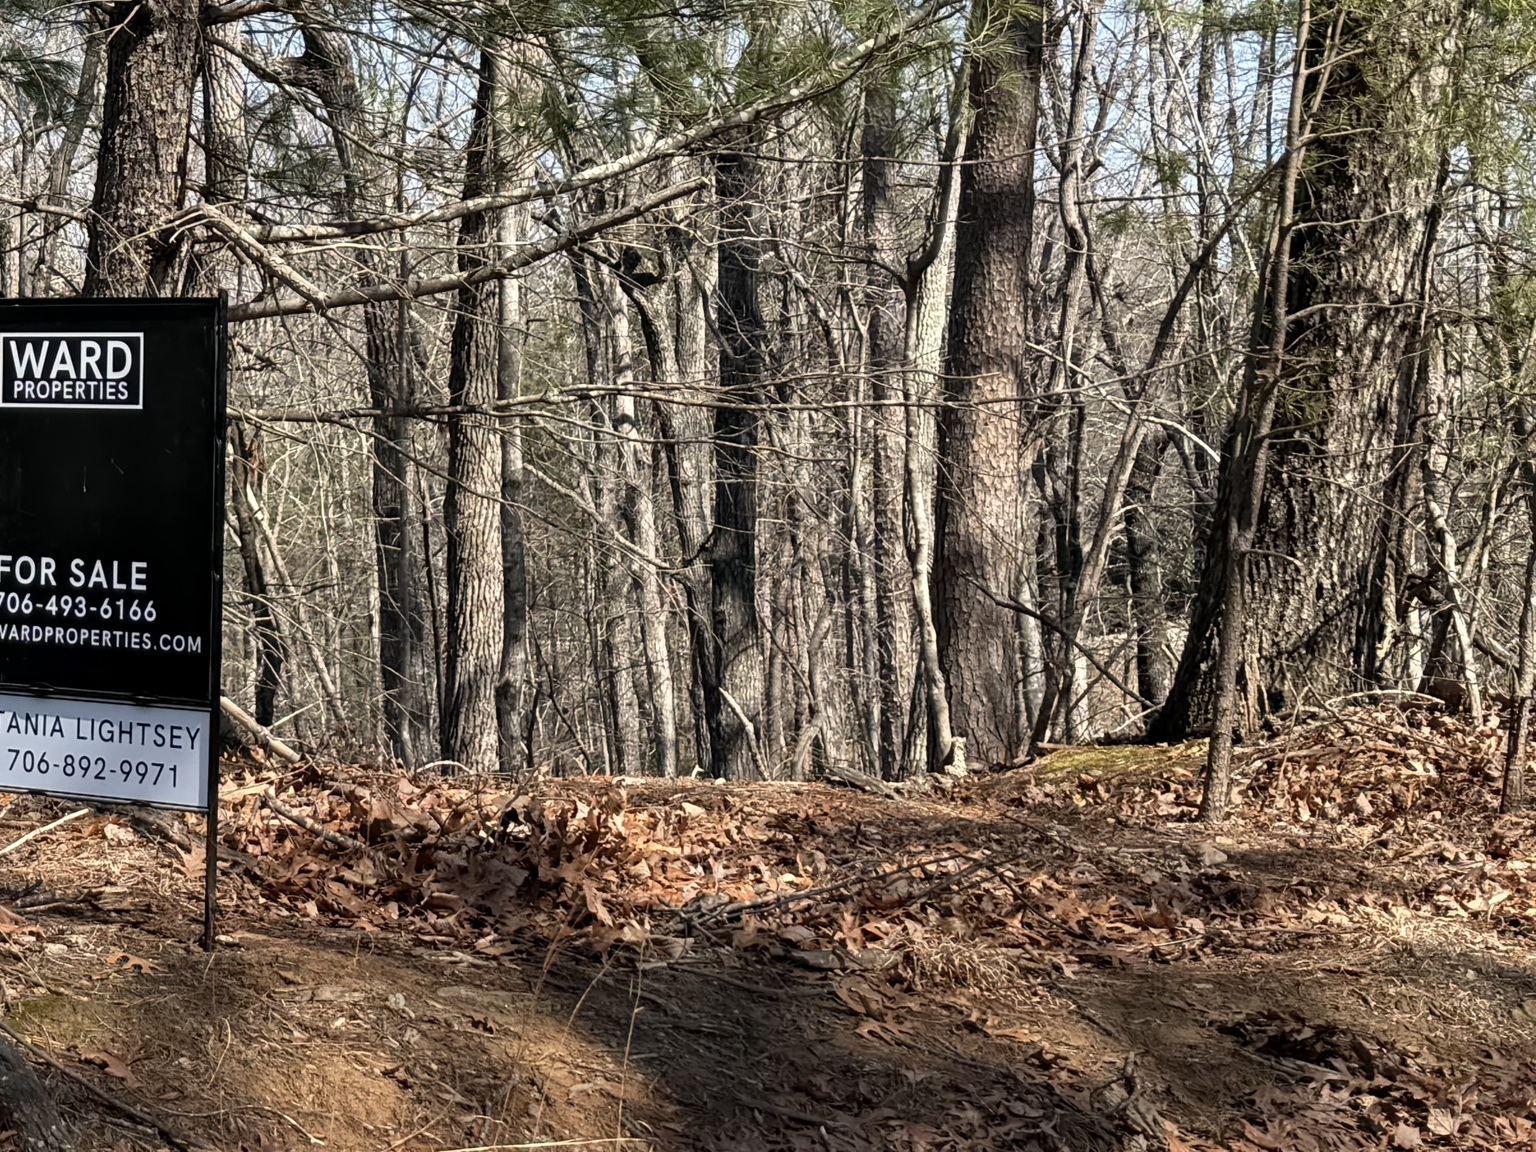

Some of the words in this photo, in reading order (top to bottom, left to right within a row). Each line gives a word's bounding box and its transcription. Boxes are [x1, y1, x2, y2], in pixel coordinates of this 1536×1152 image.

[9, 339, 132, 380] WARD
[13, 380, 129, 401] PROPERTIES
[69, 559, 148, 591] SALE
[76, 716, 201, 751] LIGHTSEY
[7, 748, 179, 788] 706-892-9971
